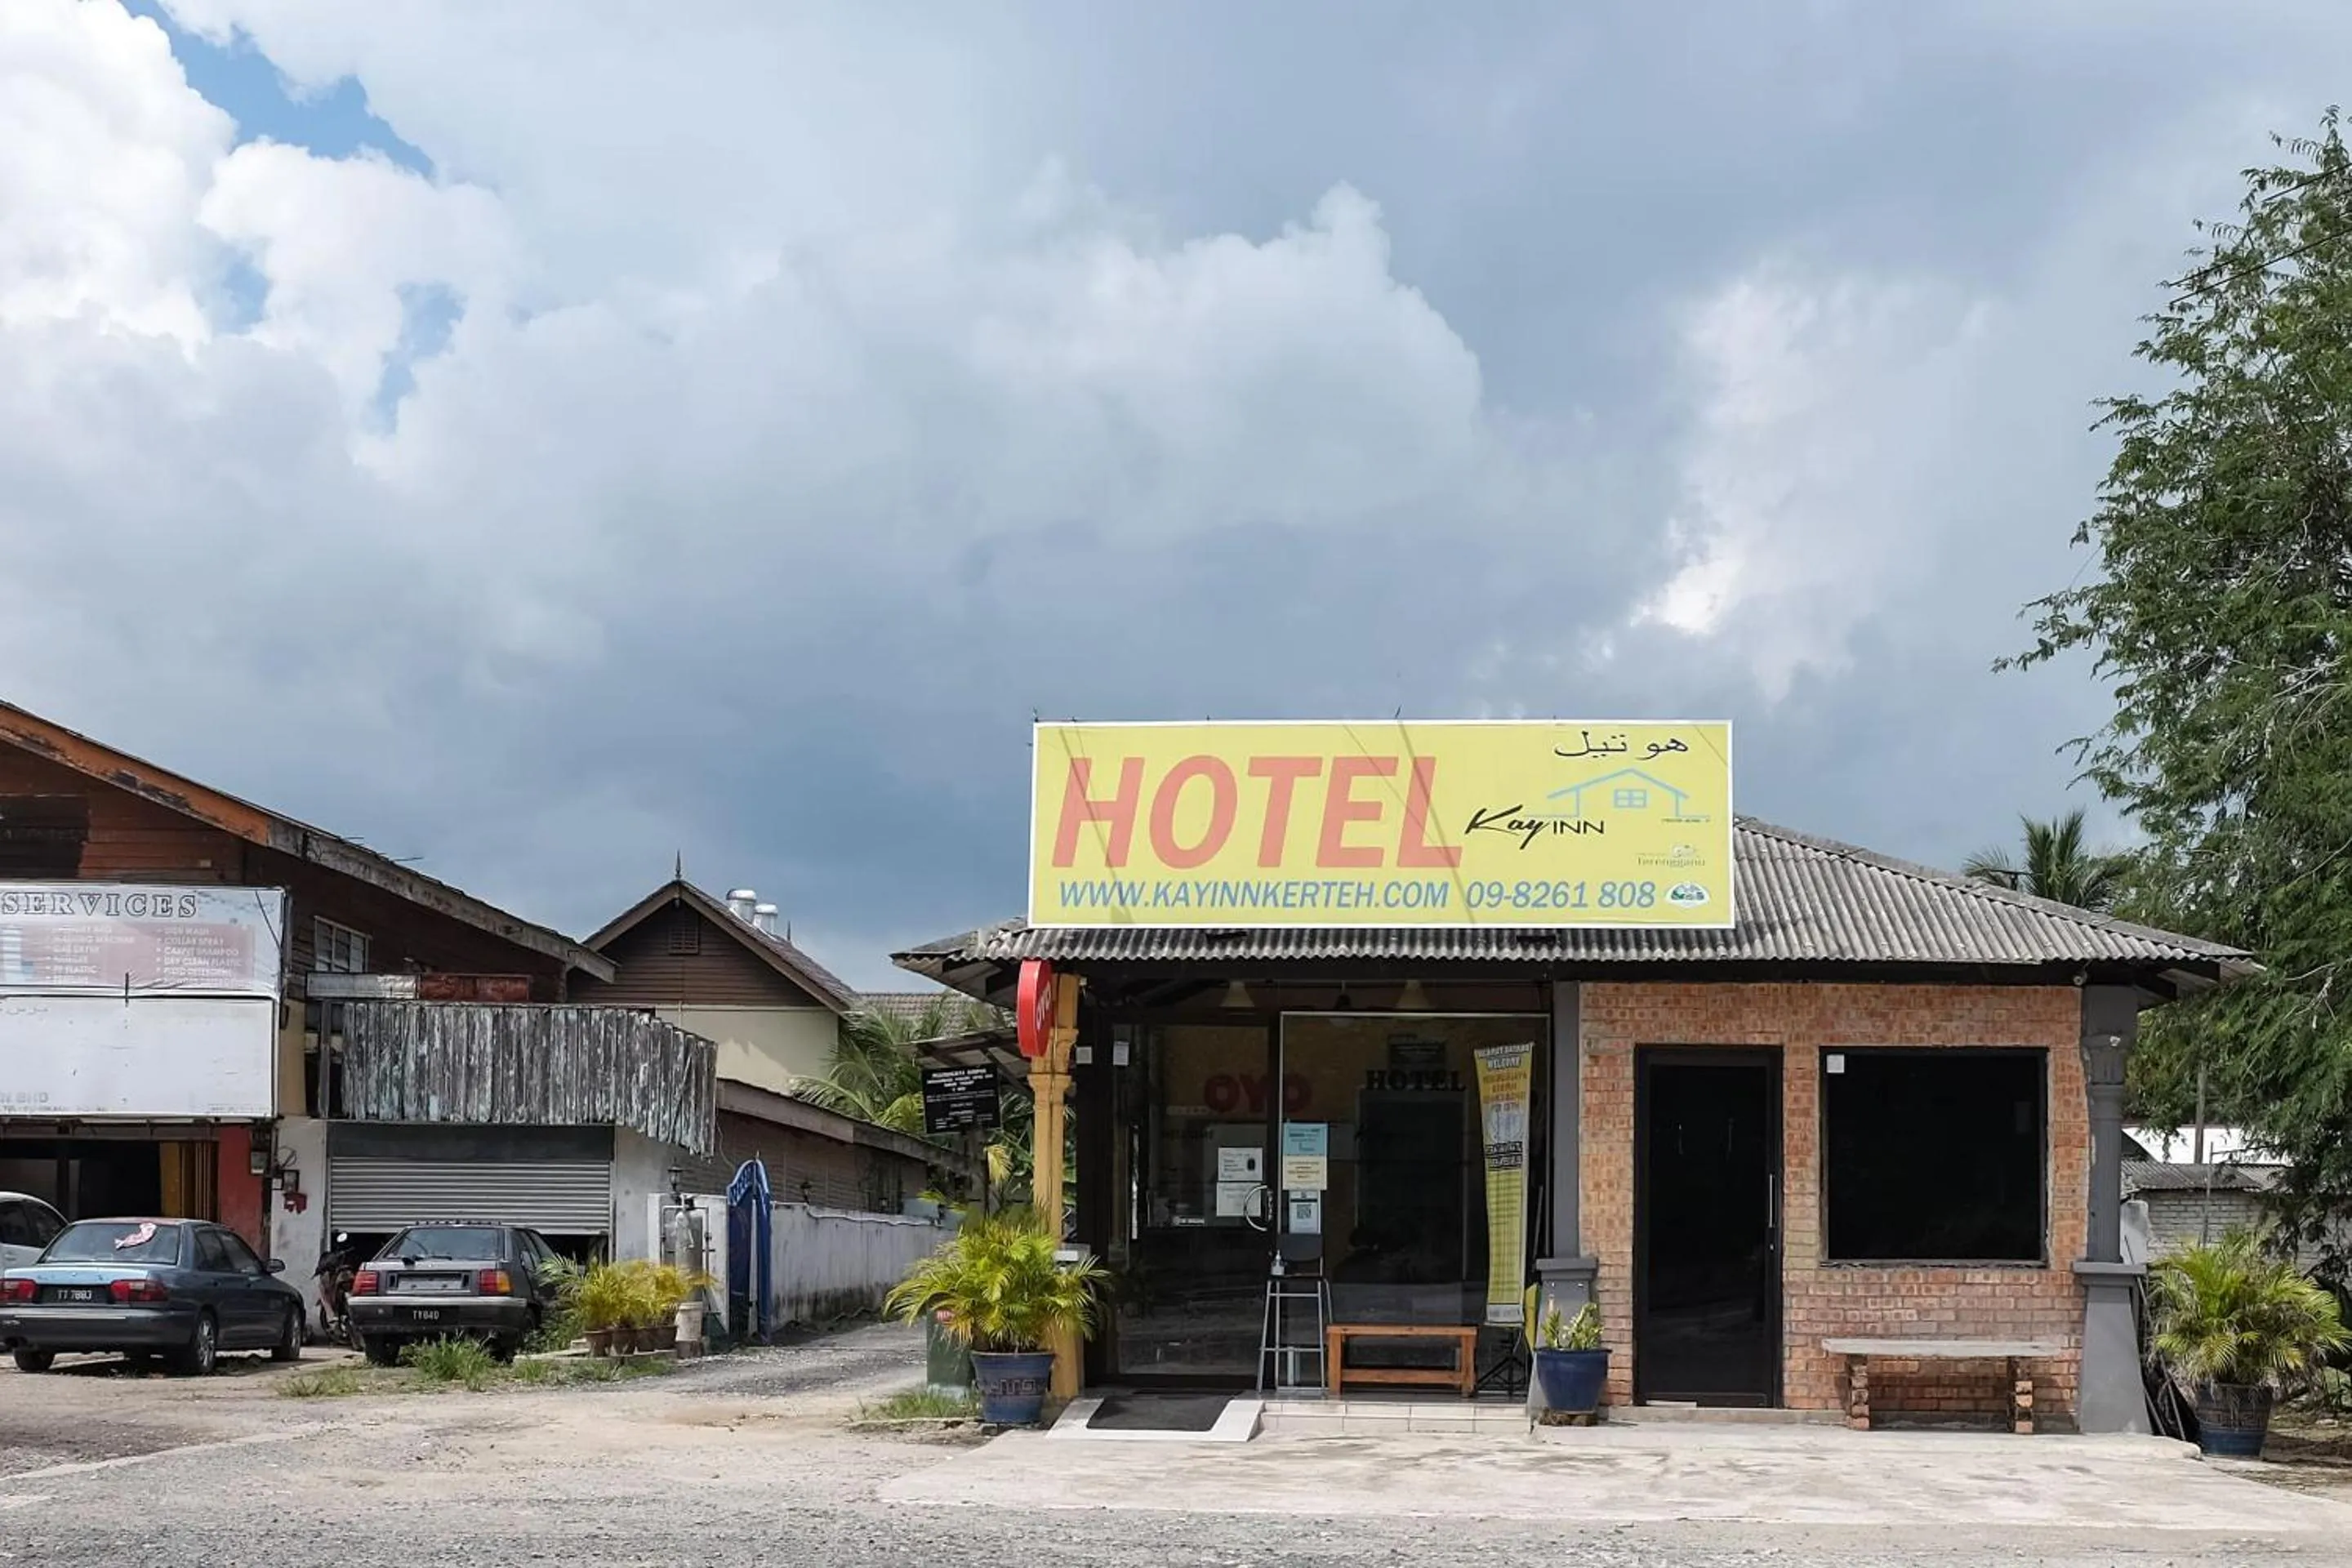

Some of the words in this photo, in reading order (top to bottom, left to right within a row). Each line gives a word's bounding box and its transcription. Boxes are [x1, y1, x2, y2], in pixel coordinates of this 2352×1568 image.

[1052, 755, 1463, 869] HOTEL
[1464, 804, 1550, 850] Kay
[1553, 820, 1605, 835] INN
[2, 892, 197, 918] SERVICES
[1059, 880, 1450, 909] WWW.KAYINNKERTEH.COM
[1466, 880, 1588, 909] 09-8261
[1597, 881, 1656, 908] 808
[1365, 1069, 1468, 1093] HOTEL
